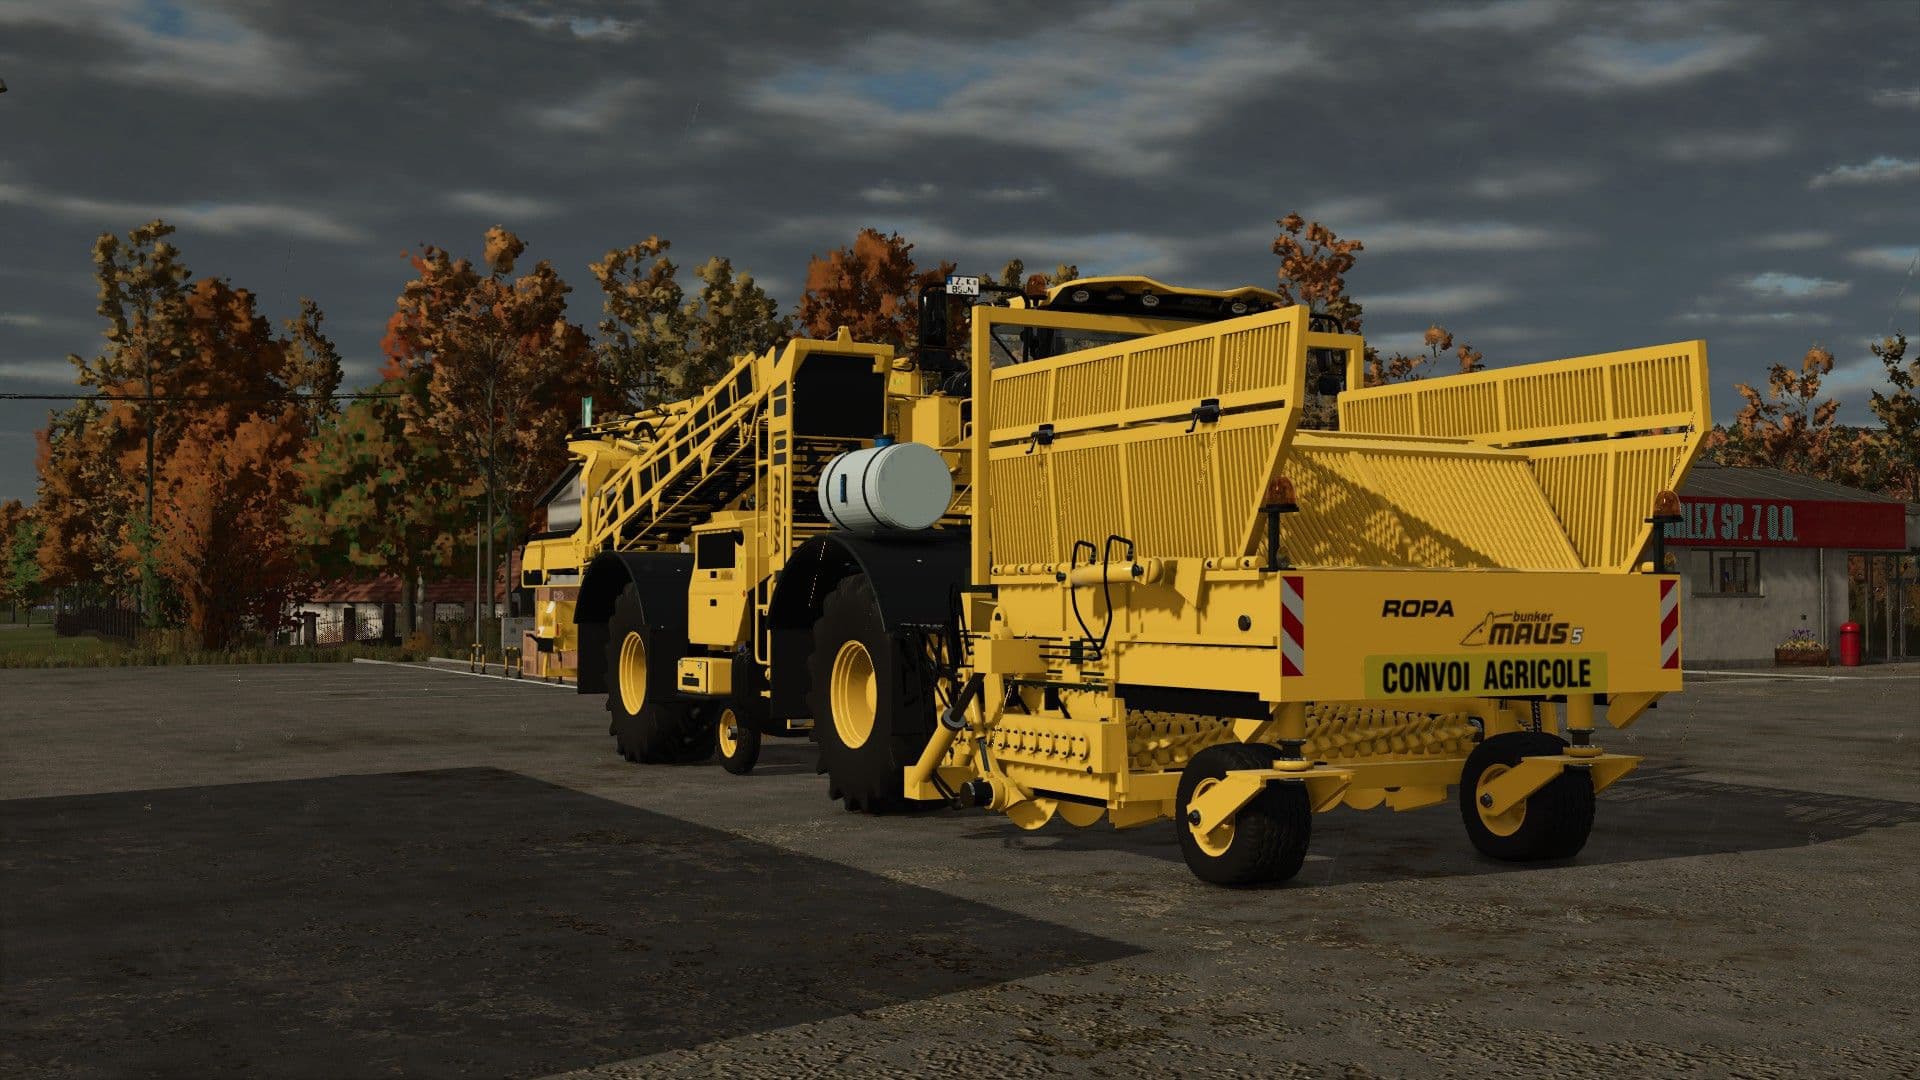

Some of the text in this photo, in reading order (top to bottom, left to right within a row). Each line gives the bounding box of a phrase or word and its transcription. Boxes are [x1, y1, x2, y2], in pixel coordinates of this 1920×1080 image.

[1720, 503, 1749, 541] SP.
[1752, 504, 1762, 542] Z
[1382, 599, 1455, 617] ROPA
[1513, 611, 1553, 622] bunker
[1488, 622, 1584, 645] MAUS 5
[1383, 658, 1591, 693] CONVOI AGRICOLE
